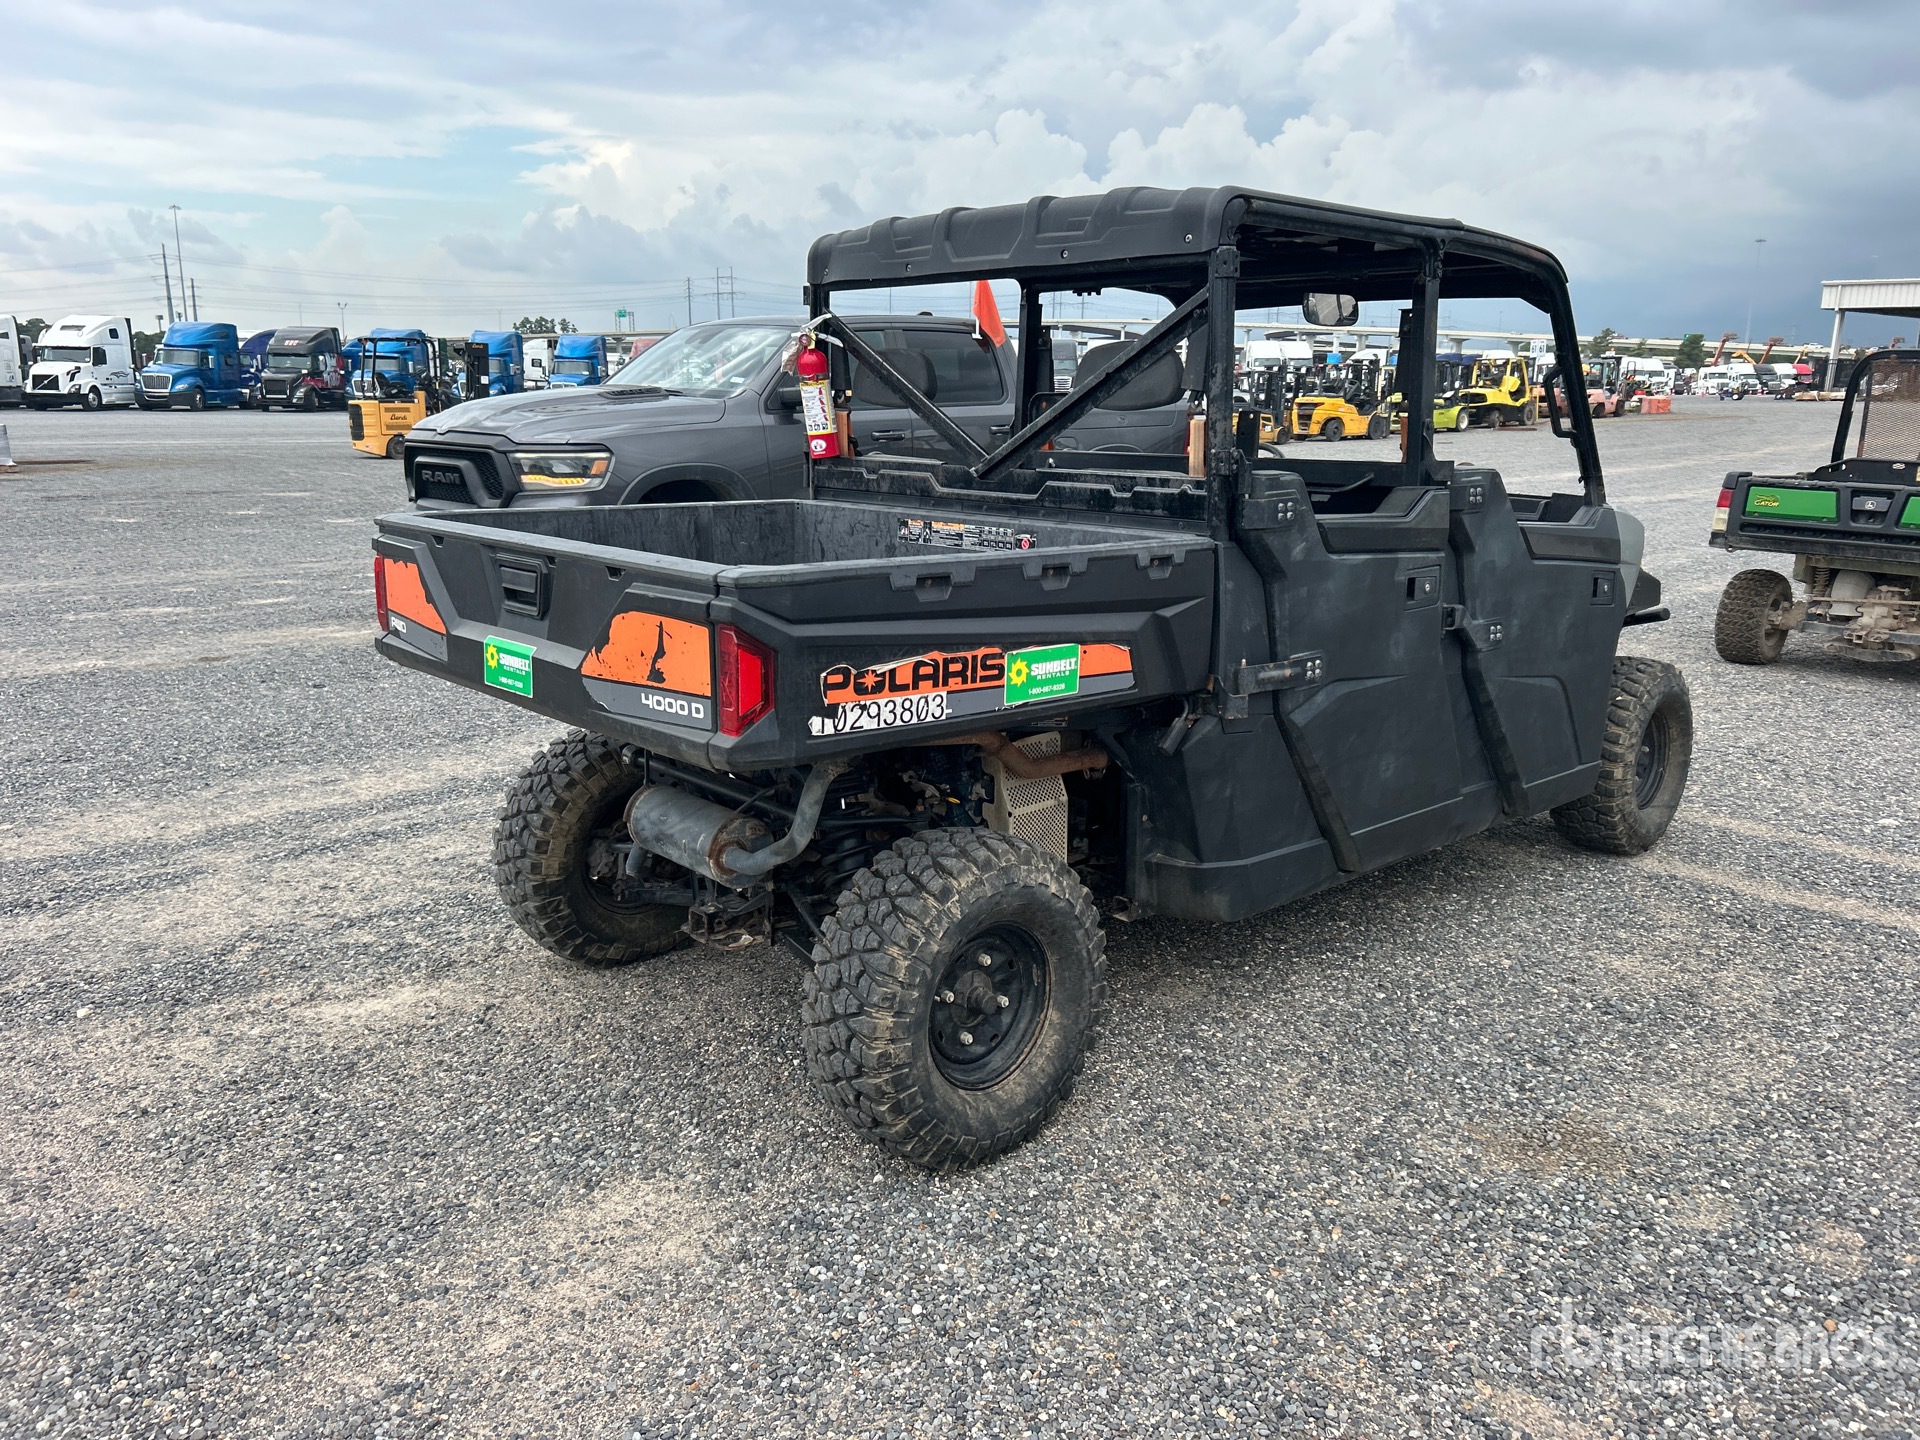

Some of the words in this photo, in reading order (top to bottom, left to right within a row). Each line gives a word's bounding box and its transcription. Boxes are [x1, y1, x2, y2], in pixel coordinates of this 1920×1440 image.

[421, 469, 461, 485] RAM
[1754, 499, 1779, 507] GATOR
[499, 652, 529, 671] SUNBELT
[503, 665, 526, 675] RENTALS
[1030, 657, 1077, 676] SUNBELT
[825, 652, 1005, 699] POLARIS
[1036, 670, 1070, 681] RENTALS
[640, 692, 689, 716] 4000
[691, 702, 705, 719] D
